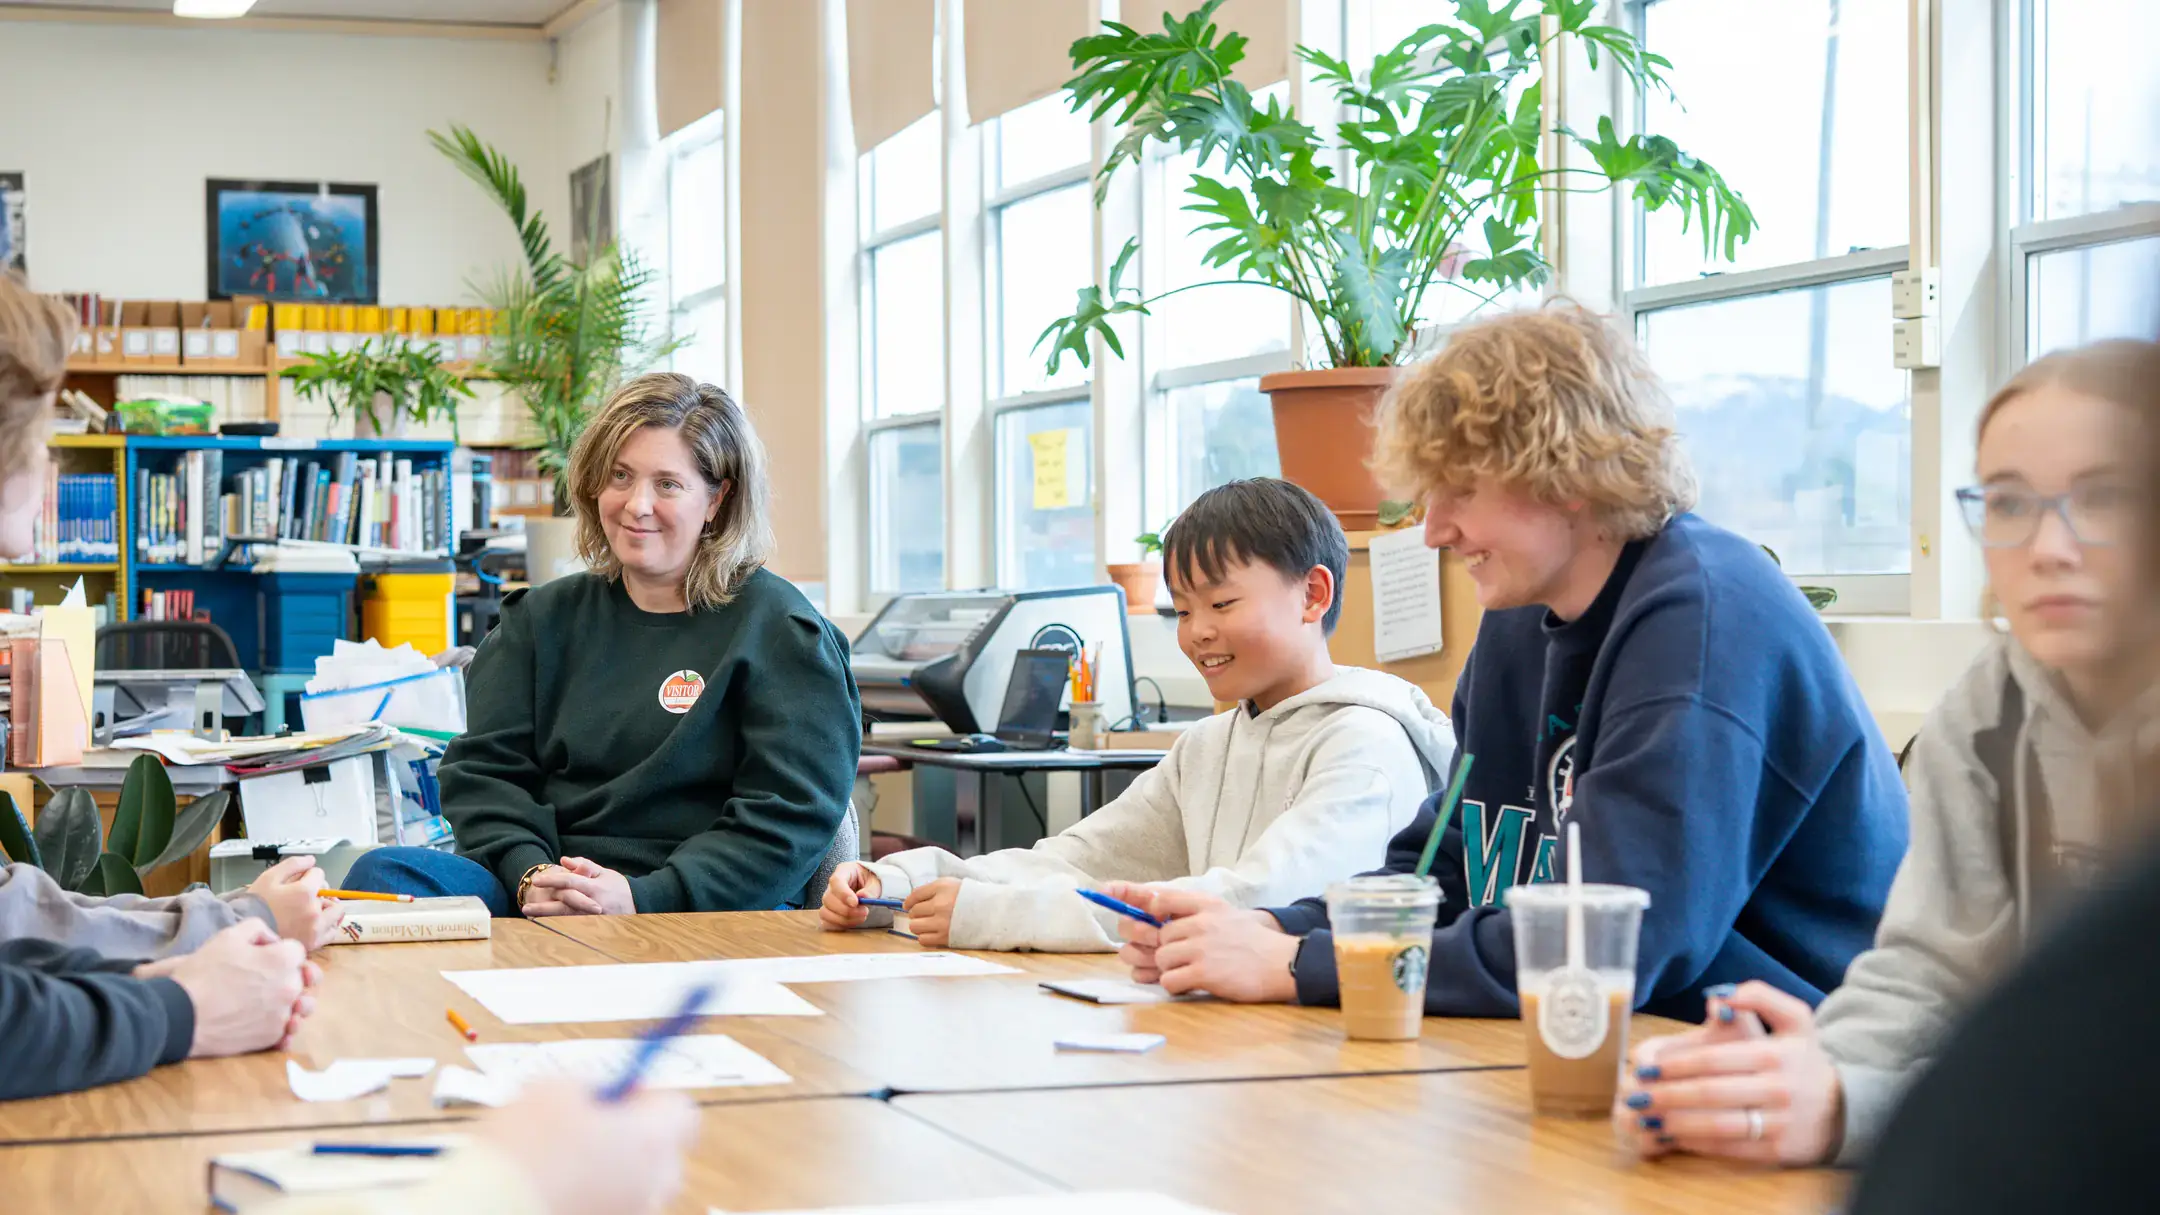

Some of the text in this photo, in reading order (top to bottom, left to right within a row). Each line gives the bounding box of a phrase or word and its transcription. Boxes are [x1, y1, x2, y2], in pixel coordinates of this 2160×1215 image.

[666, 685, 699, 697] VISITOR
[372, 922, 480, 938] Sharon McMahon
